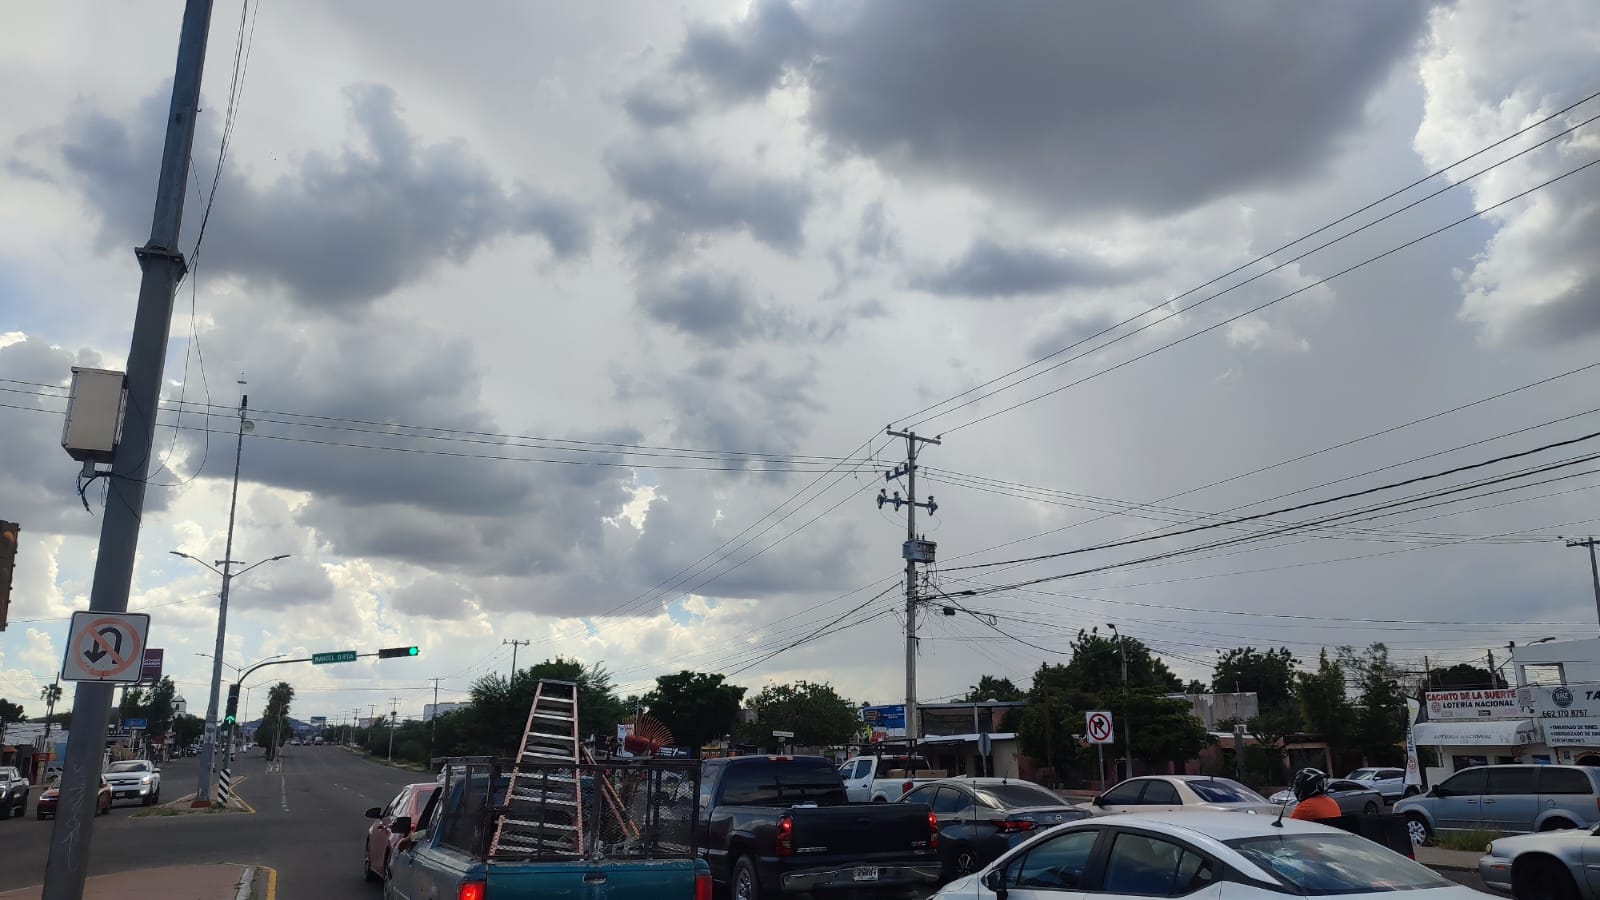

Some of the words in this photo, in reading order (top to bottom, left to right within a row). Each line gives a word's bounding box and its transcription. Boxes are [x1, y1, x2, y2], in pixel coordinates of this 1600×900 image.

[1427, 692, 1458, 702] CACHITO
[1460, 691, 1470, 700] DE
[1472, 691, 1482, 699] LA
[1484, 688, 1517, 699] SUERTE
[1475, 699, 1515, 708] NACIONAL
